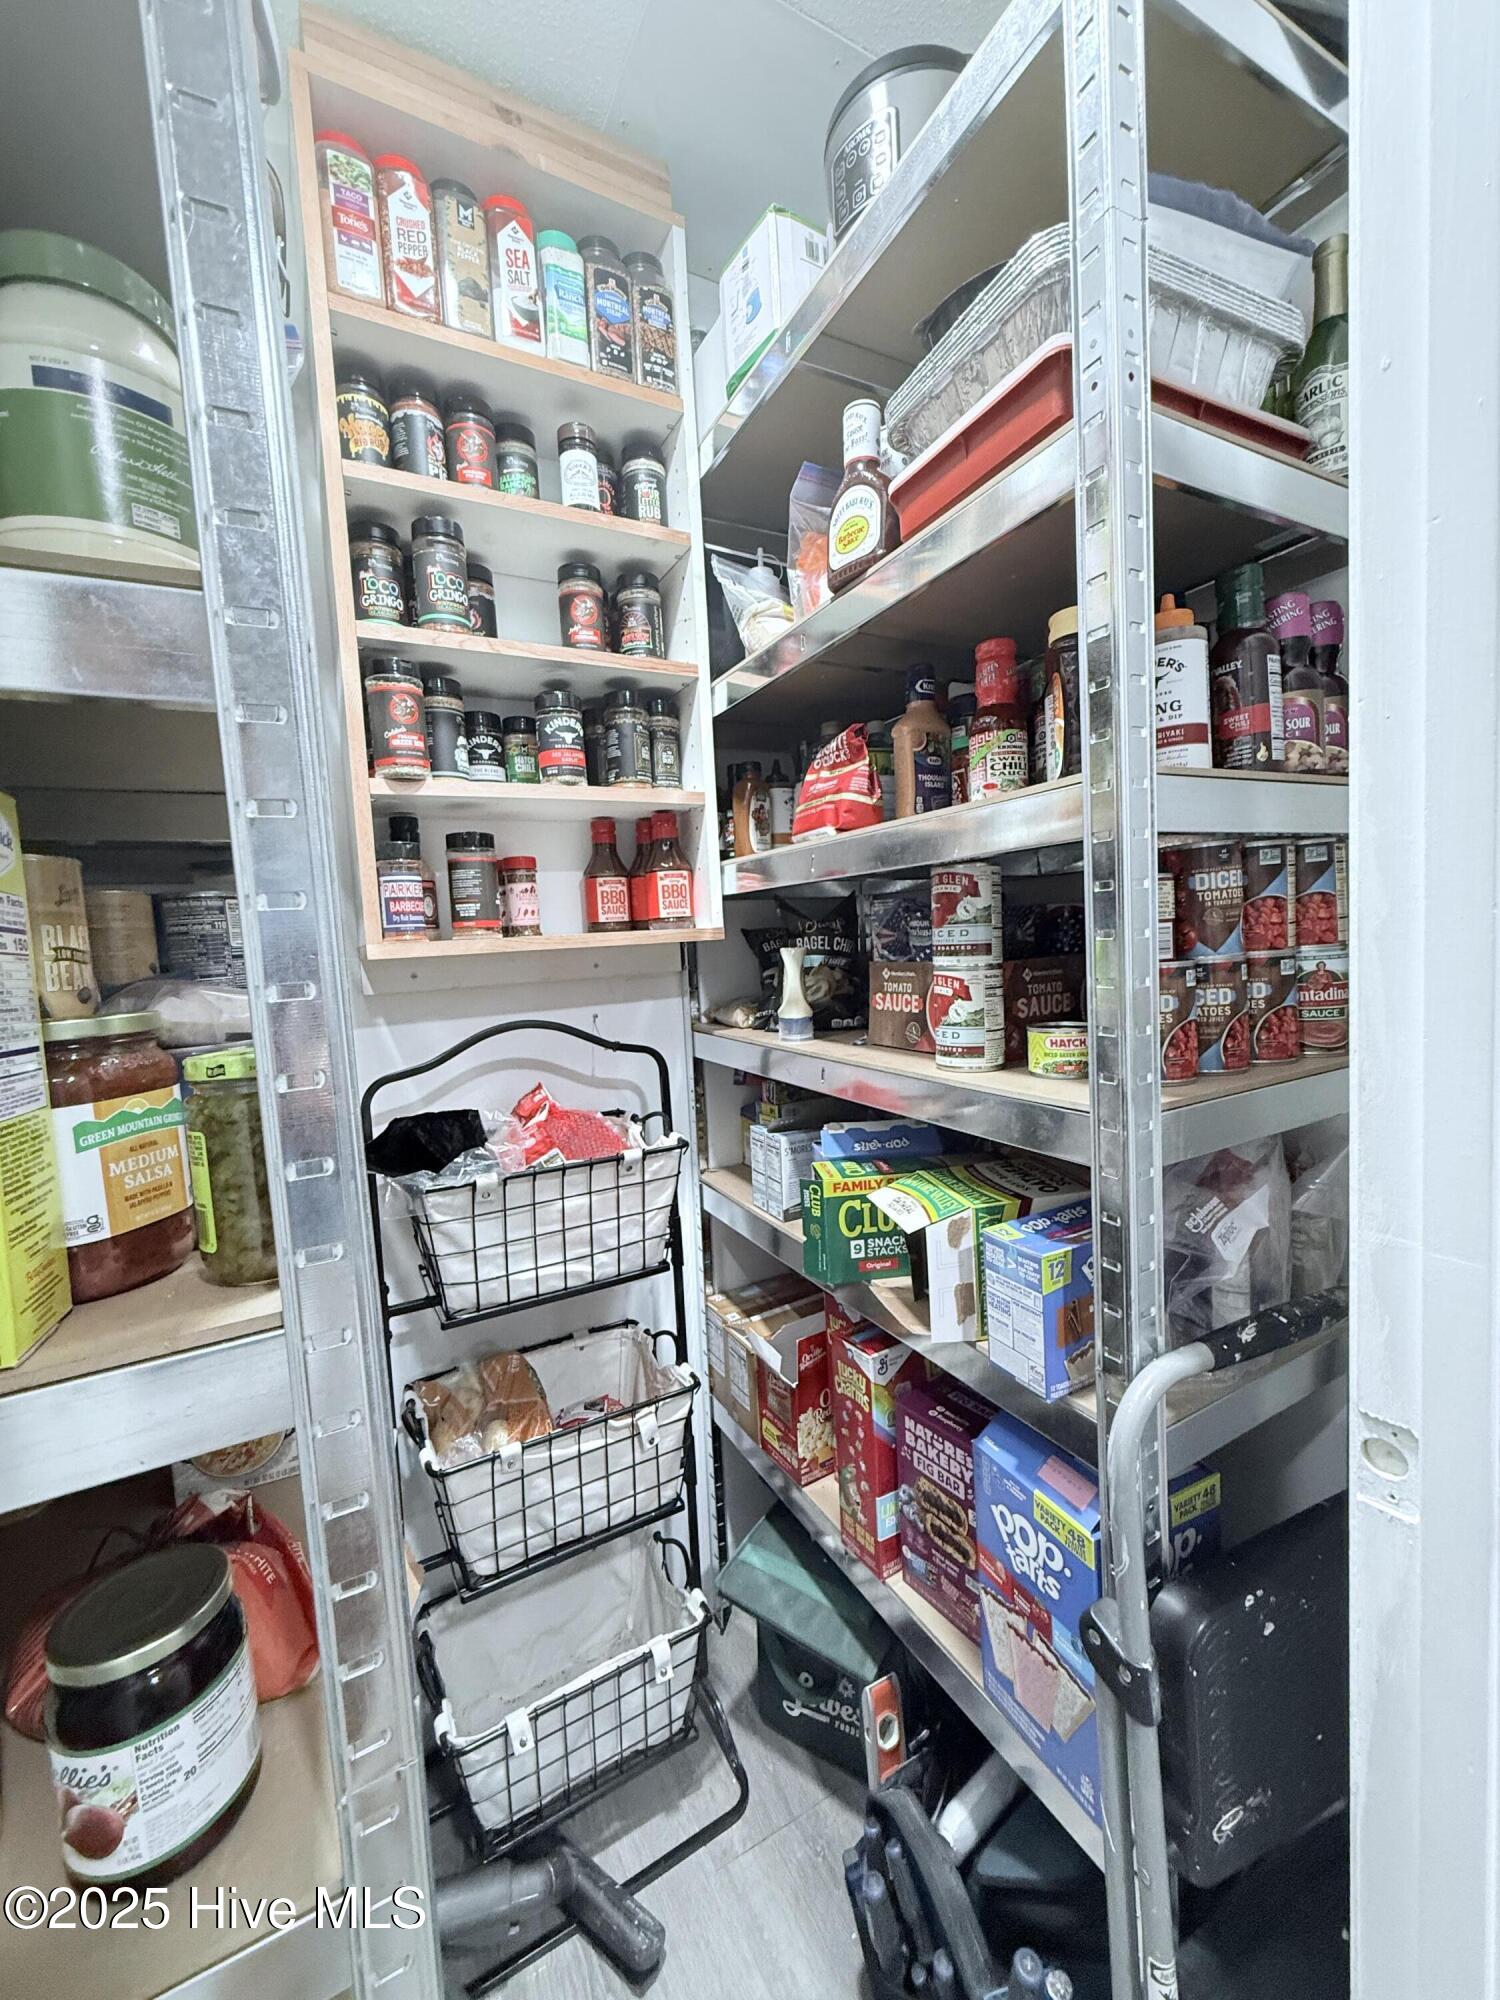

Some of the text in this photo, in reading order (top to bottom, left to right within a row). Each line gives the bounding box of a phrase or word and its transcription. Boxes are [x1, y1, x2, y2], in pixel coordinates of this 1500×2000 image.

[340, 187, 363, 202] TACO
[337, 212, 369, 233] Tone's
[397, 227, 427, 244] RED
[397, 241, 428, 257] PEPPER
[505, 248, 531, 270] SEA
[507, 270, 531, 286] SALT
[596, 298, 630, 317] MONTREAL
[638, 505, 662, 519] RUB
[363, 575, 399, 596] LOCO
[431, 571, 465, 591] LOCO
[361, 593, 405, 612] GRINGO
[429, 589, 469, 608] GRINGO
[1285, 717, 1311, 730] SOUR
[942, 875, 969, 886] GLEN
[1195, 869, 1243, 891] DICED
[600, 889, 626, 905] BBQ
[661, 884, 688, 899] BBQ
[1196, 888, 1244, 902] TOMATOES
[601, 904, 627, 915] SAUCE
[662, 899, 689, 911] SAUCE
[796, 936, 831, 951] BAGEL
[883, 982, 912, 993] TOMATO
[938, 977, 960, 989] GLEN
[1027, 981, 1063, 995] TOMATO
[875, 993, 920, 1013] SAUCE
[1017, 992, 1072, 1019] SAUCE
[1302, 1009, 1340, 1018] SAUCE
[1049, 1038, 1087, 1048] HATCH
[79, 1115, 163, 1147] GREEN MOUNTAIN
[108, 1144, 180, 1177] MEDIUM
[124, 1165, 173, 1189] SALSA
[832, 1179, 883, 1194] FAMILY
[808, 1184, 822, 1218] CLUB
[853, 1242, 862, 1255] 9
[867, 1236, 906, 1248] SNACK
[867, 1245, 908, 1257] STACKS
[865, 1261, 891, 1269] Original
[1047, 1259, 1065, 1281] 12
[904, 1415, 974, 1470] NATURE'S
[905, 1429, 974, 1484] BAKERY
[916, 1454, 961, 1495] FIG BAR
[1173, 1483, 1217, 1513] VARIETY 48
[1179, 1504, 1198, 1520] PACK
[1034, 1500, 1086, 1549] VARIETY 48
[1040, 1512, 1061, 1536] PACK
[1006, 1543, 1061, 1601] tarts
[134, 1723, 181, 1753] Nutrition
[134, 1743, 165, 1763] Facts
[183, 1765, 198, 1783] 20
